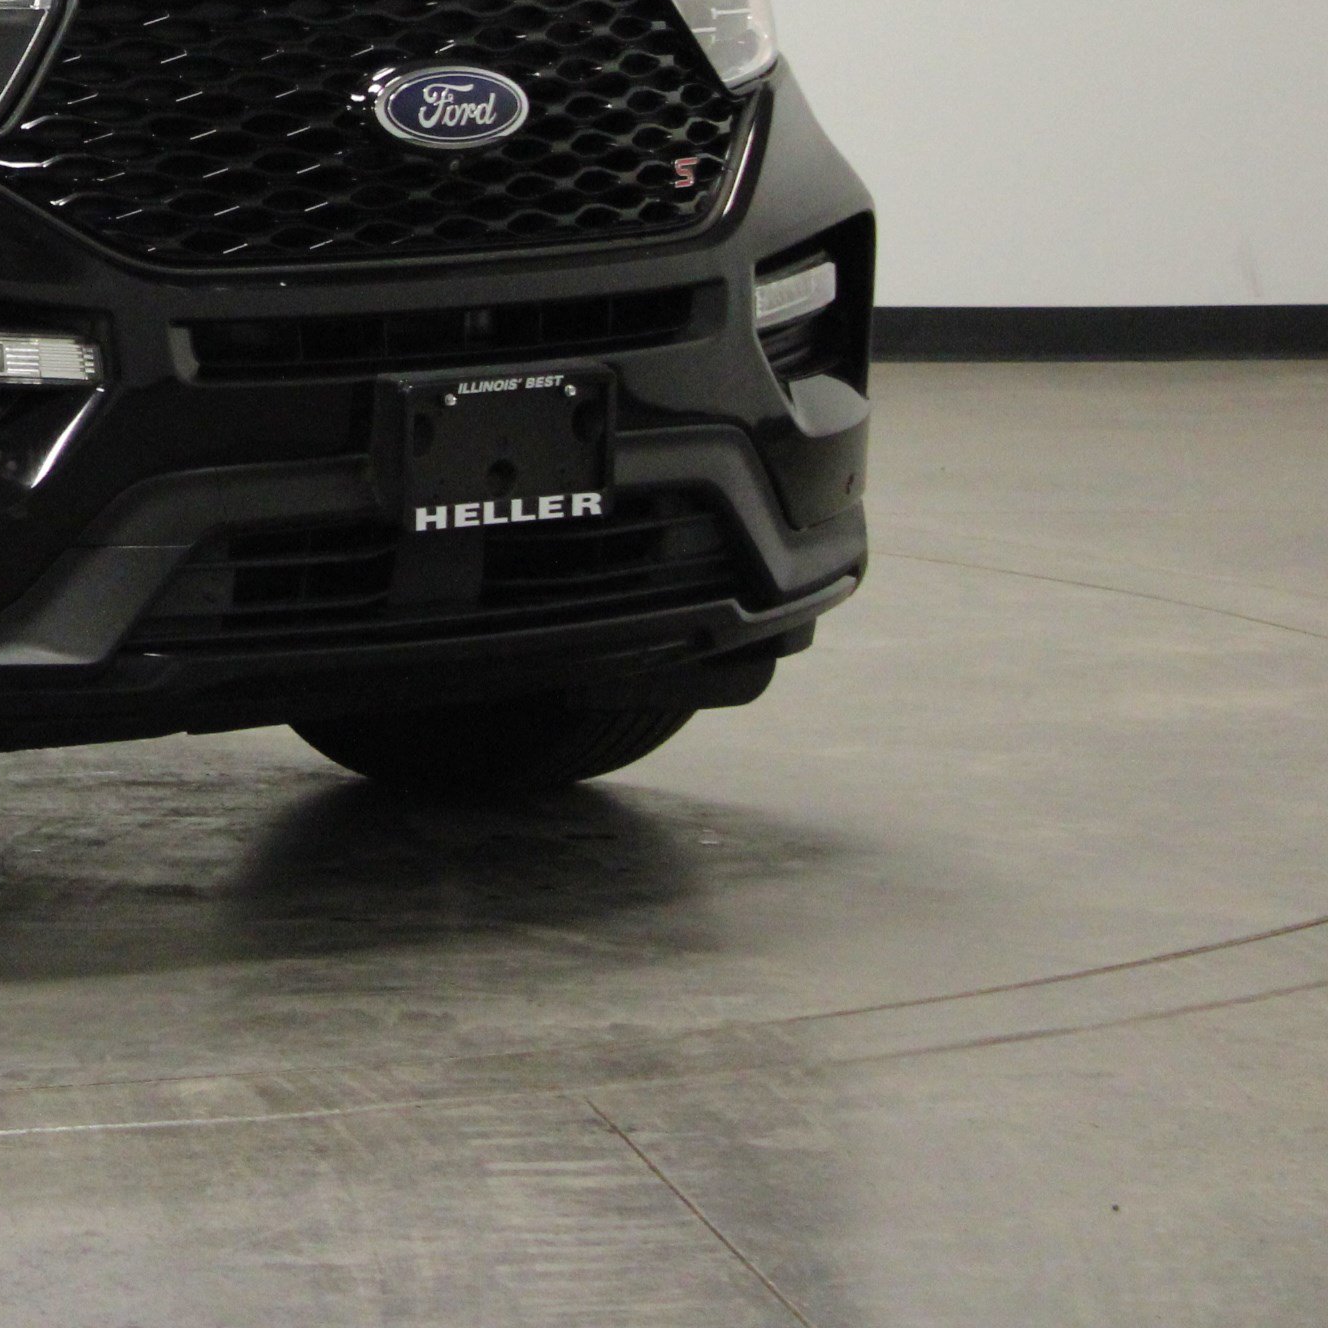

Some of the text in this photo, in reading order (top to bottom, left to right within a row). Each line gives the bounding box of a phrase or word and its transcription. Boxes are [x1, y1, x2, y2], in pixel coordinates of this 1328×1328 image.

[417, 83, 498, 128] Ford
[457, 374, 565, 395] ILLINOIS' BEST
[414, 492, 603, 532] HELLER
